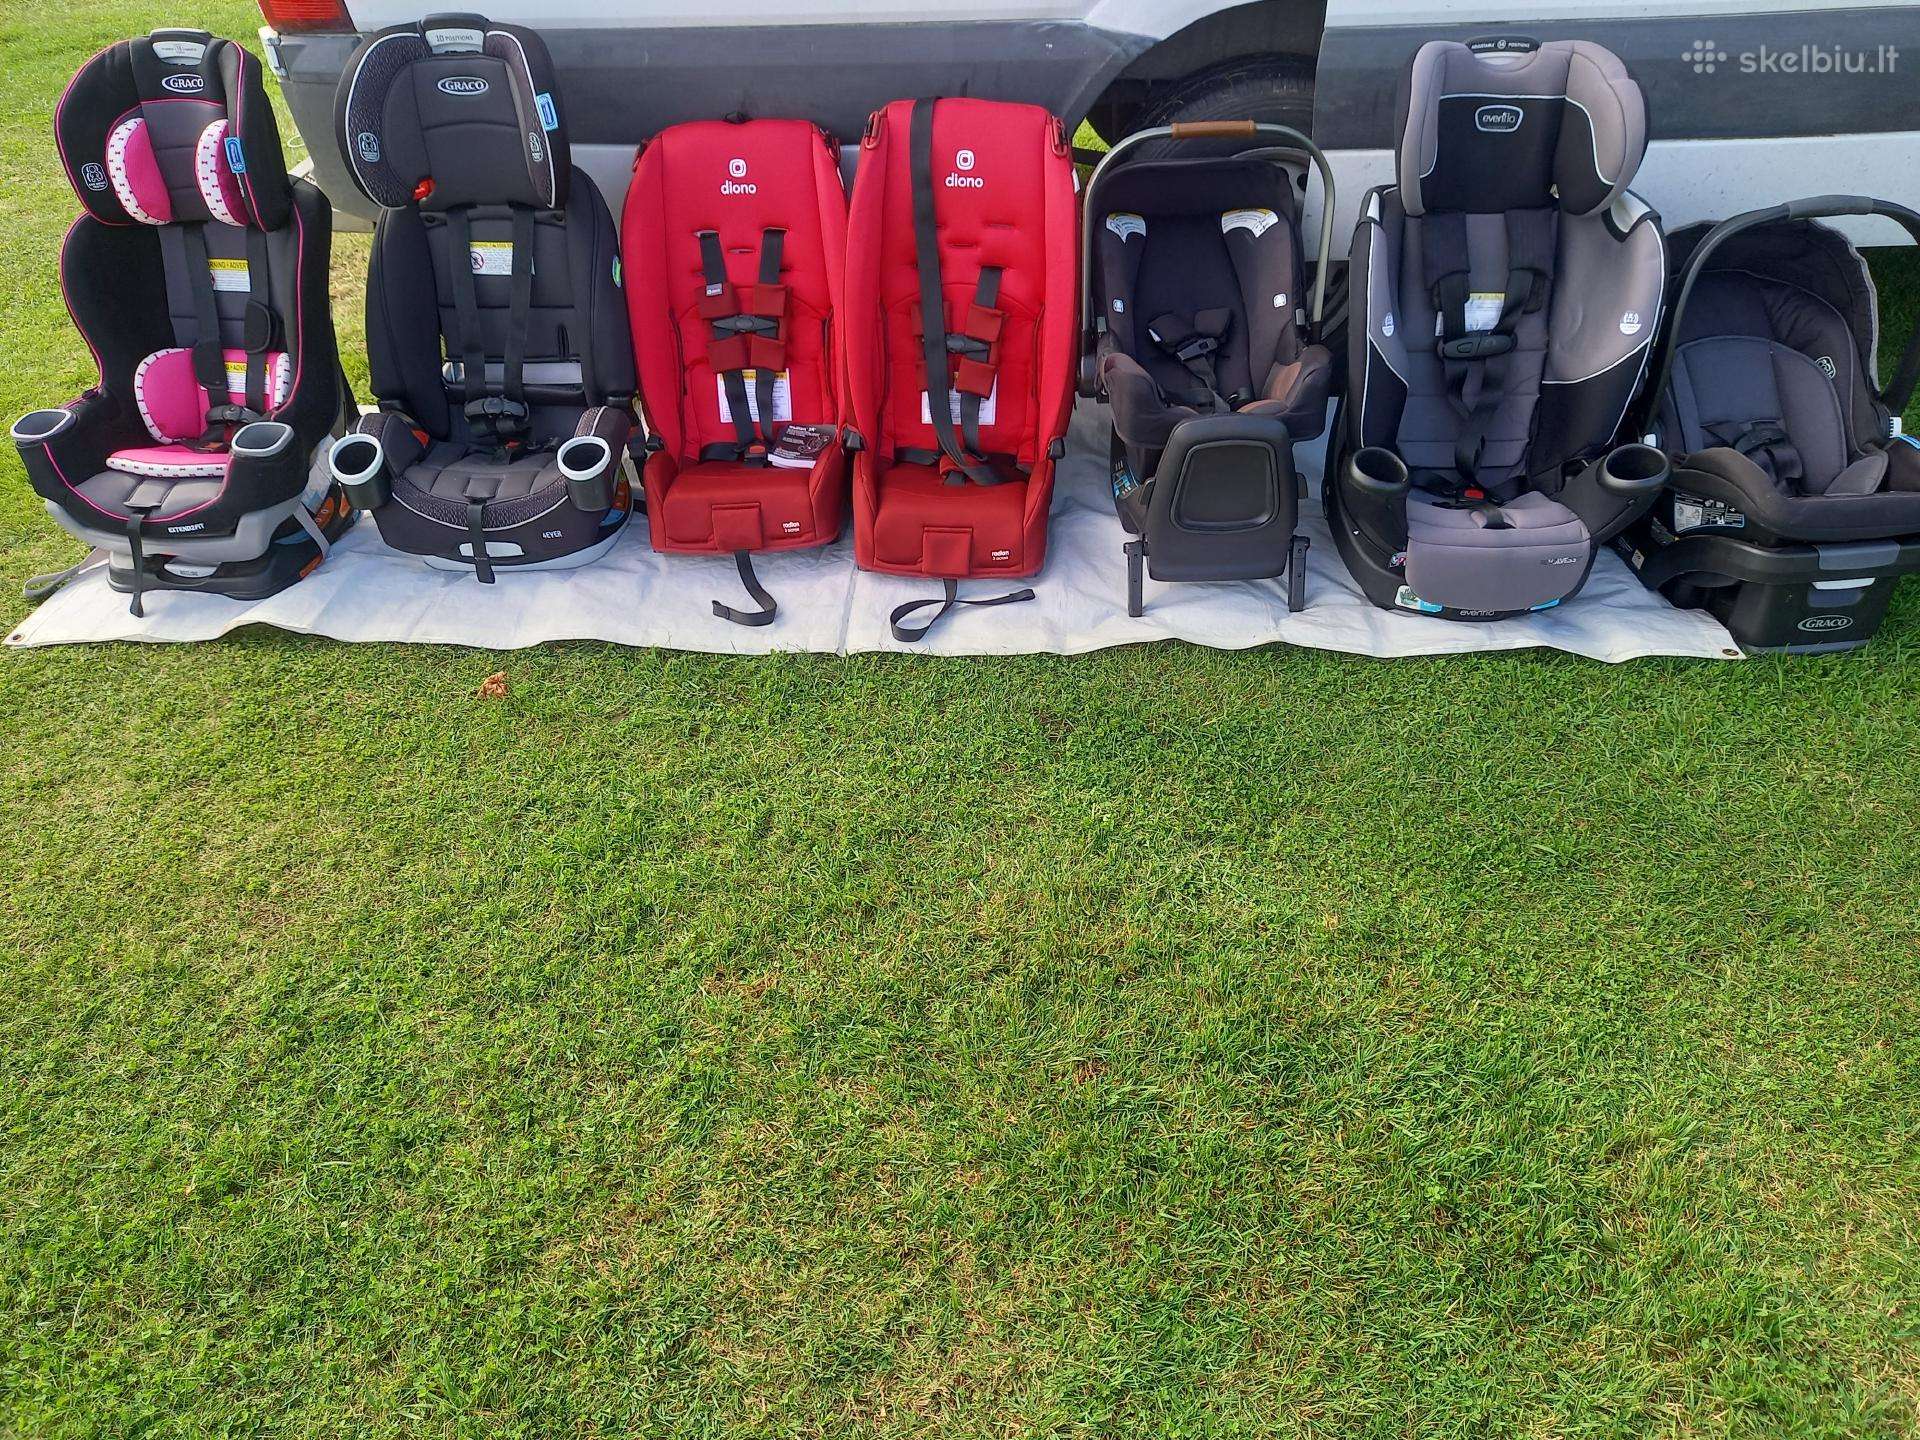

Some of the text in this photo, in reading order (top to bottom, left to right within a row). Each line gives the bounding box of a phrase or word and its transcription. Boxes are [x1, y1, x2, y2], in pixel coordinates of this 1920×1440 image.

[170, 78, 204, 88] GRACO
[445, 80, 485, 91] GRACO
[1482, 111, 1516, 124] evenflo
[945, 172, 984, 188] diono
[720, 179, 757, 195] diono
[1805, 618, 1848, 629] GRACO
